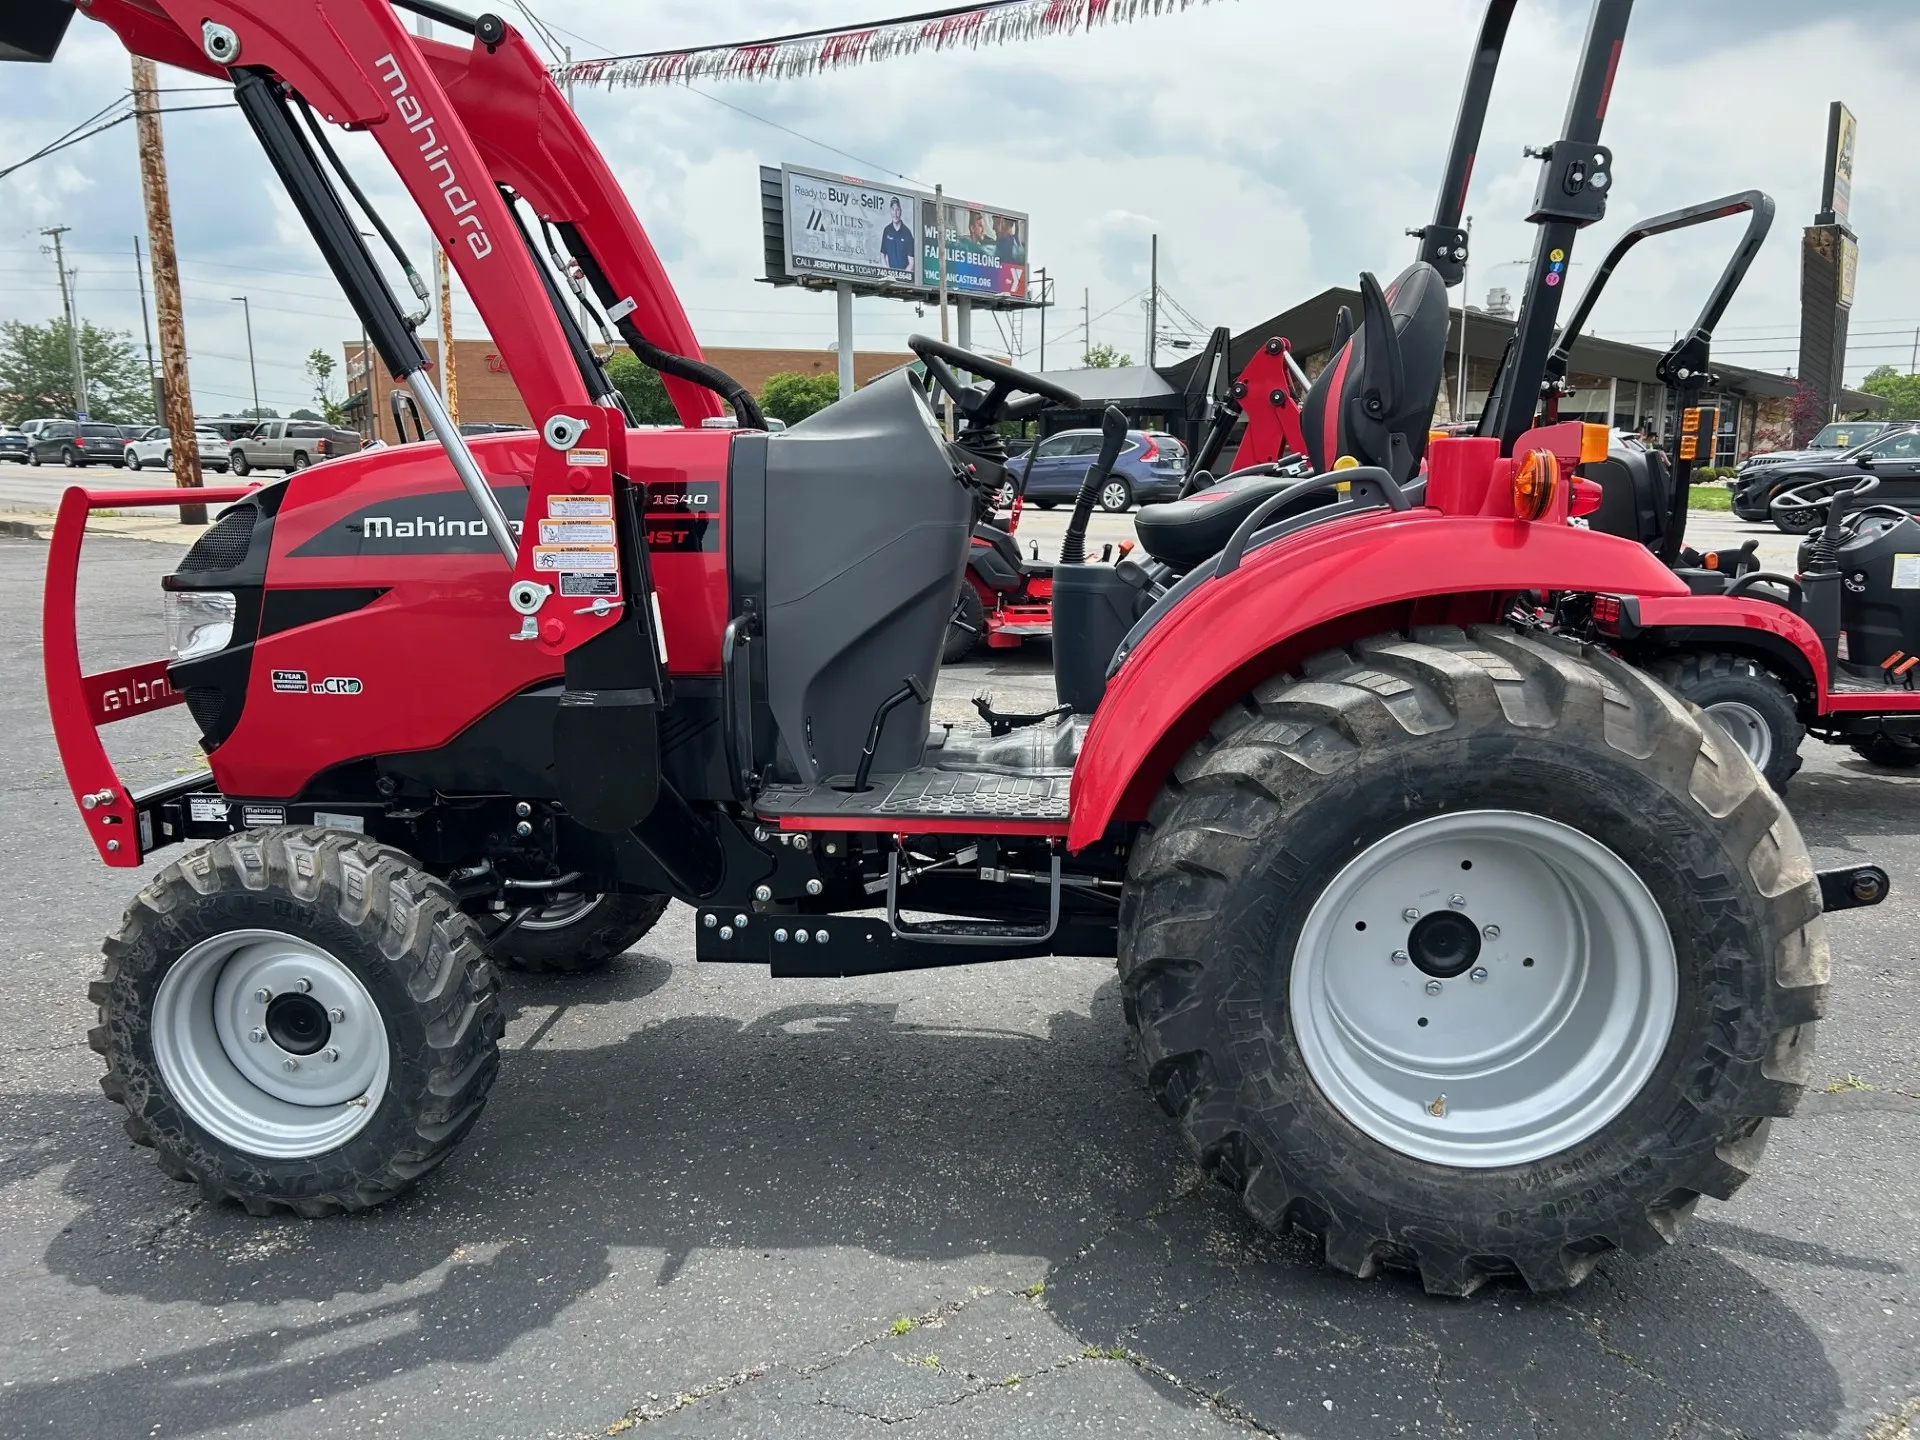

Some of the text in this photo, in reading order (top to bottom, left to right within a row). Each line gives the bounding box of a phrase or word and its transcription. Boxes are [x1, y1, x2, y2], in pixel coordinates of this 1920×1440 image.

[374, 53, 492, 260] mahindra
[794, 184, 884, 210] Ready to Buy or Sell?
[830, 213, 864, 229] MILLS
[924, 225, 957, 242] WHRE
[795, 257, 812, 266] CALL
[813, 260, 837, 270] JEREMY
[837, 263, 855, 272] MILLS
[924, 245, 1003, 269] FAILIES BELONG.
[652, 494, 709, 505] 1640
[363, 515, 523, 538] Mahinda
[278, 672, 283, 680] 7
[244, 807, 283, 815] Mahindra
